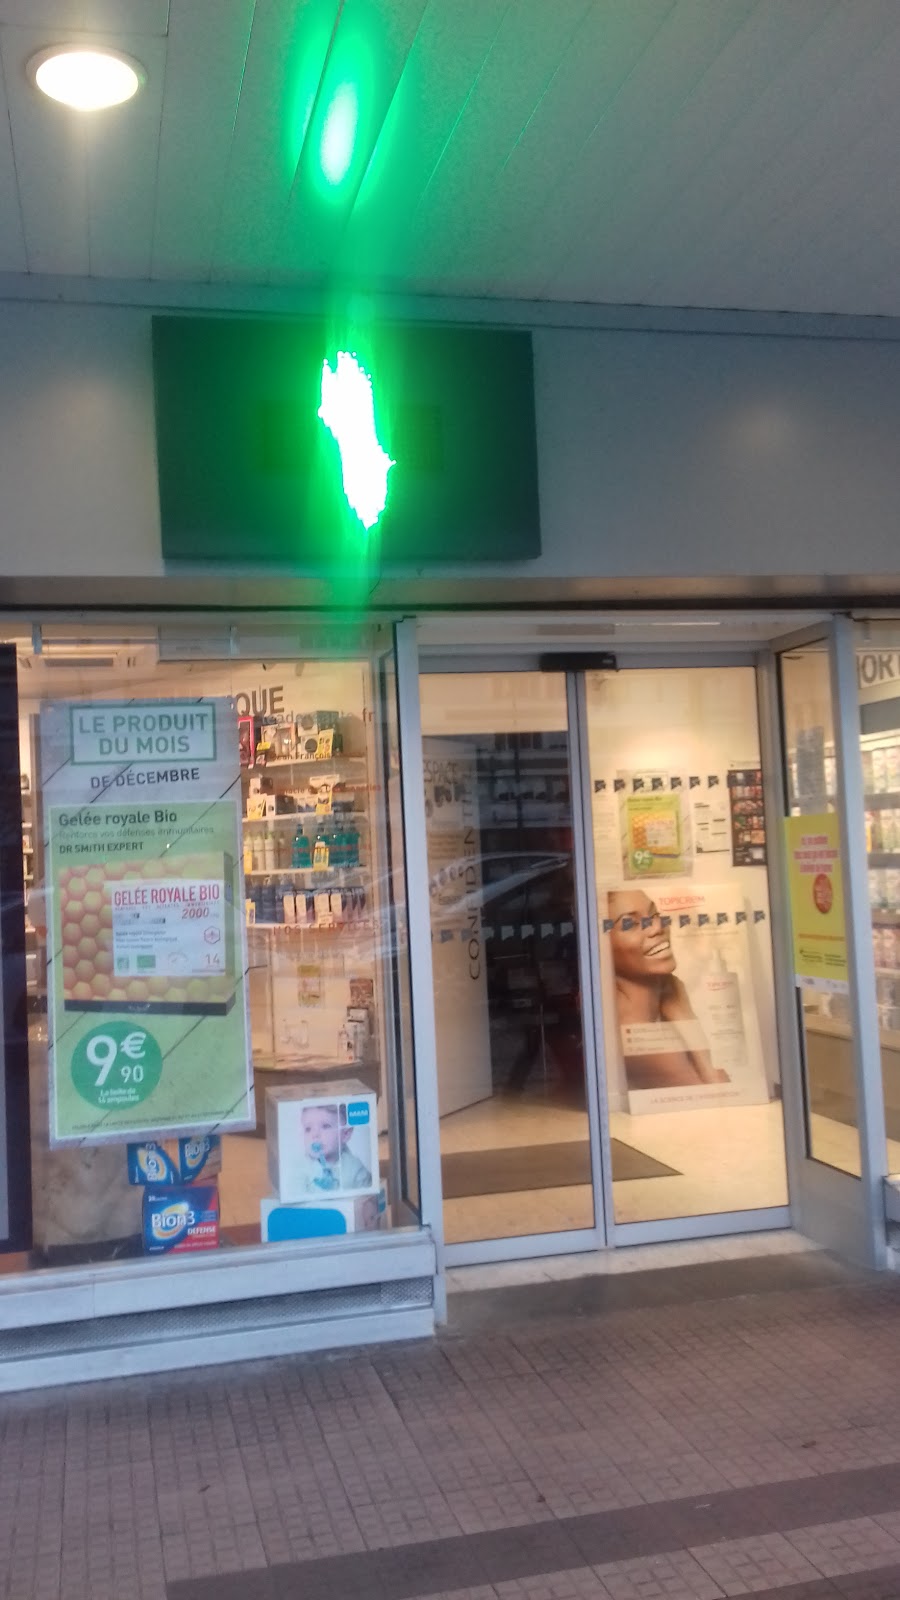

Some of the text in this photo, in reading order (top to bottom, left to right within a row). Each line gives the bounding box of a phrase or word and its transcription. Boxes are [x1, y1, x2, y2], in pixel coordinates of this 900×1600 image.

[78, 712, 209, 734] LE PRODUIT
[99, 735, 191, 756] DU MOIS
[91, 768, 200, 789] DE DÉCEMBRE
[58, 809, 178, 828] Gelée royale Bio
[116, 828, 156, 838] défenses
[59, 840, 145, 855] DR SMITH EXPERT
[114, 887, 148, 907] GELÉE
[150, 885, 197, 904] ROYALE
[199, 883, 221, 902] BIO
[181, 907, 210, 920] 2000
[204, 953, 220, 966] 14
[120, 1064, 144, 1083] 90
[151, 1210, 196, 1229] Bion3
[187, 1226, 217, 1236] DEFENSE
